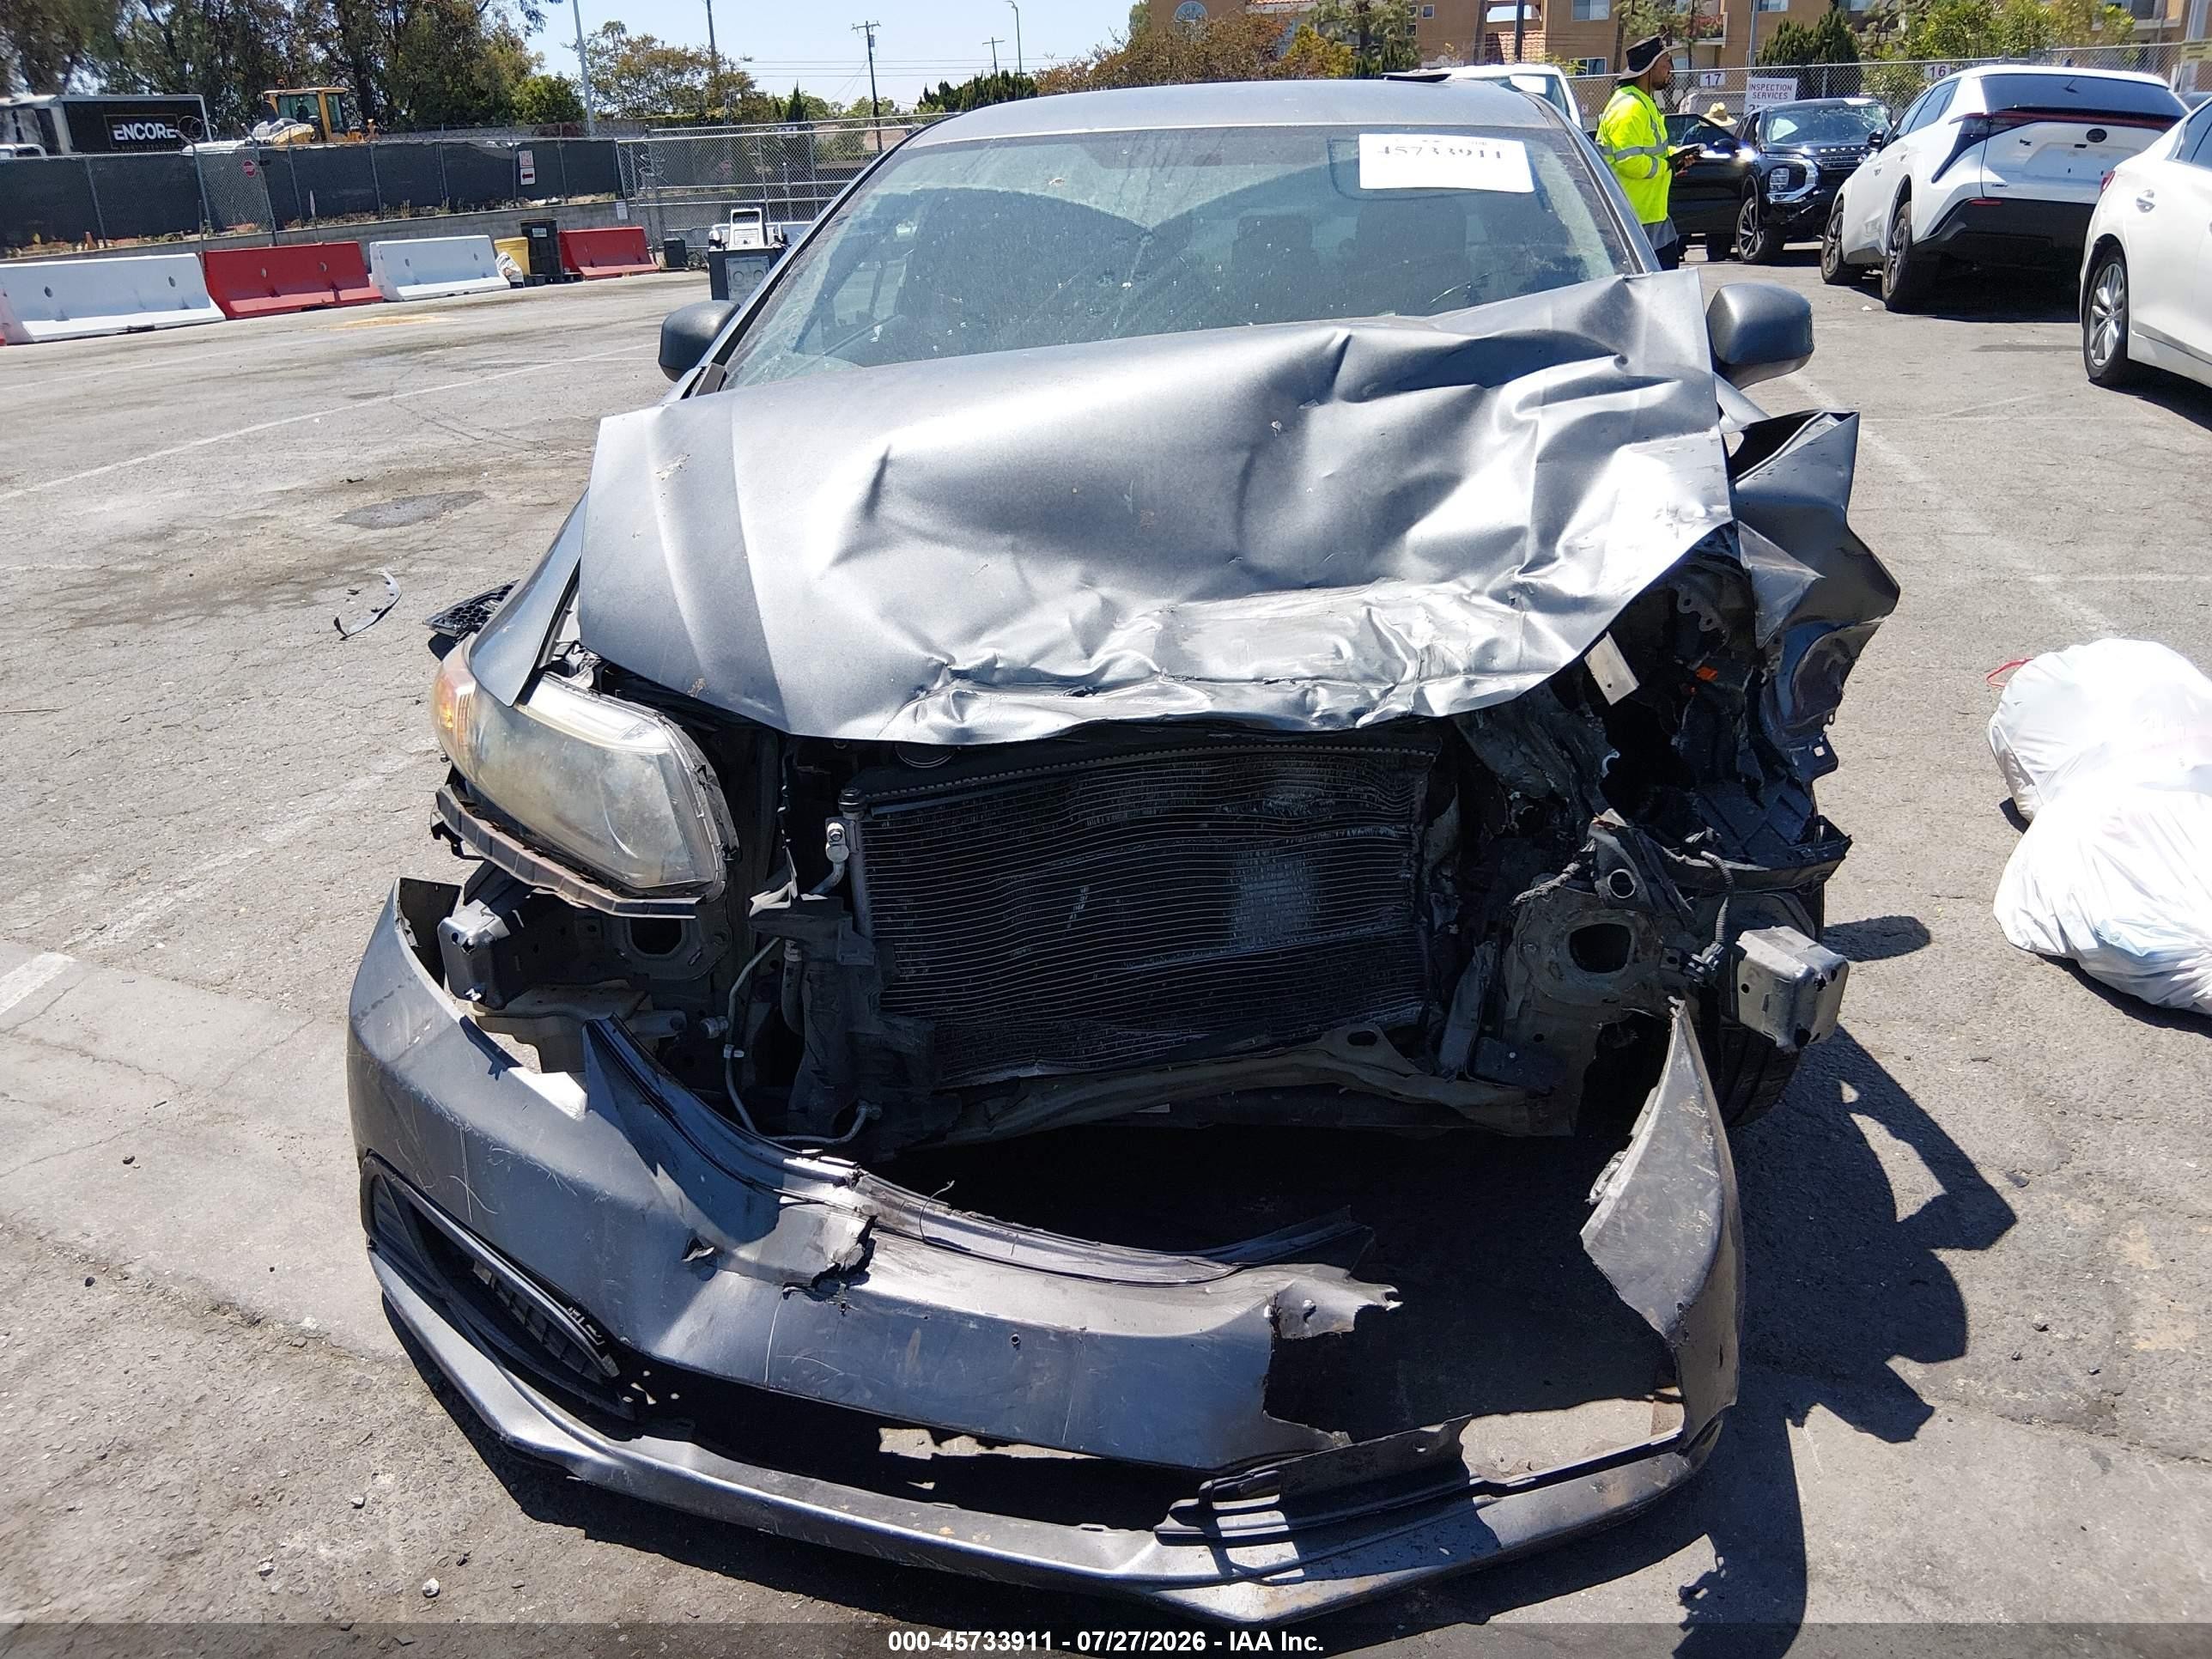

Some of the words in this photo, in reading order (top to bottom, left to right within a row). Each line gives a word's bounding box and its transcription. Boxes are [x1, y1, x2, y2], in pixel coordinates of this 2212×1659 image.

[1929, 65, 1947, 77] 16
[1705, 73, 1722, 86] 17
[1747, 83, 1793, 92] INSPECTION
[1752, 91, 1789, 100] SERVICES
[112, 122, 178, 141] ENCORE
